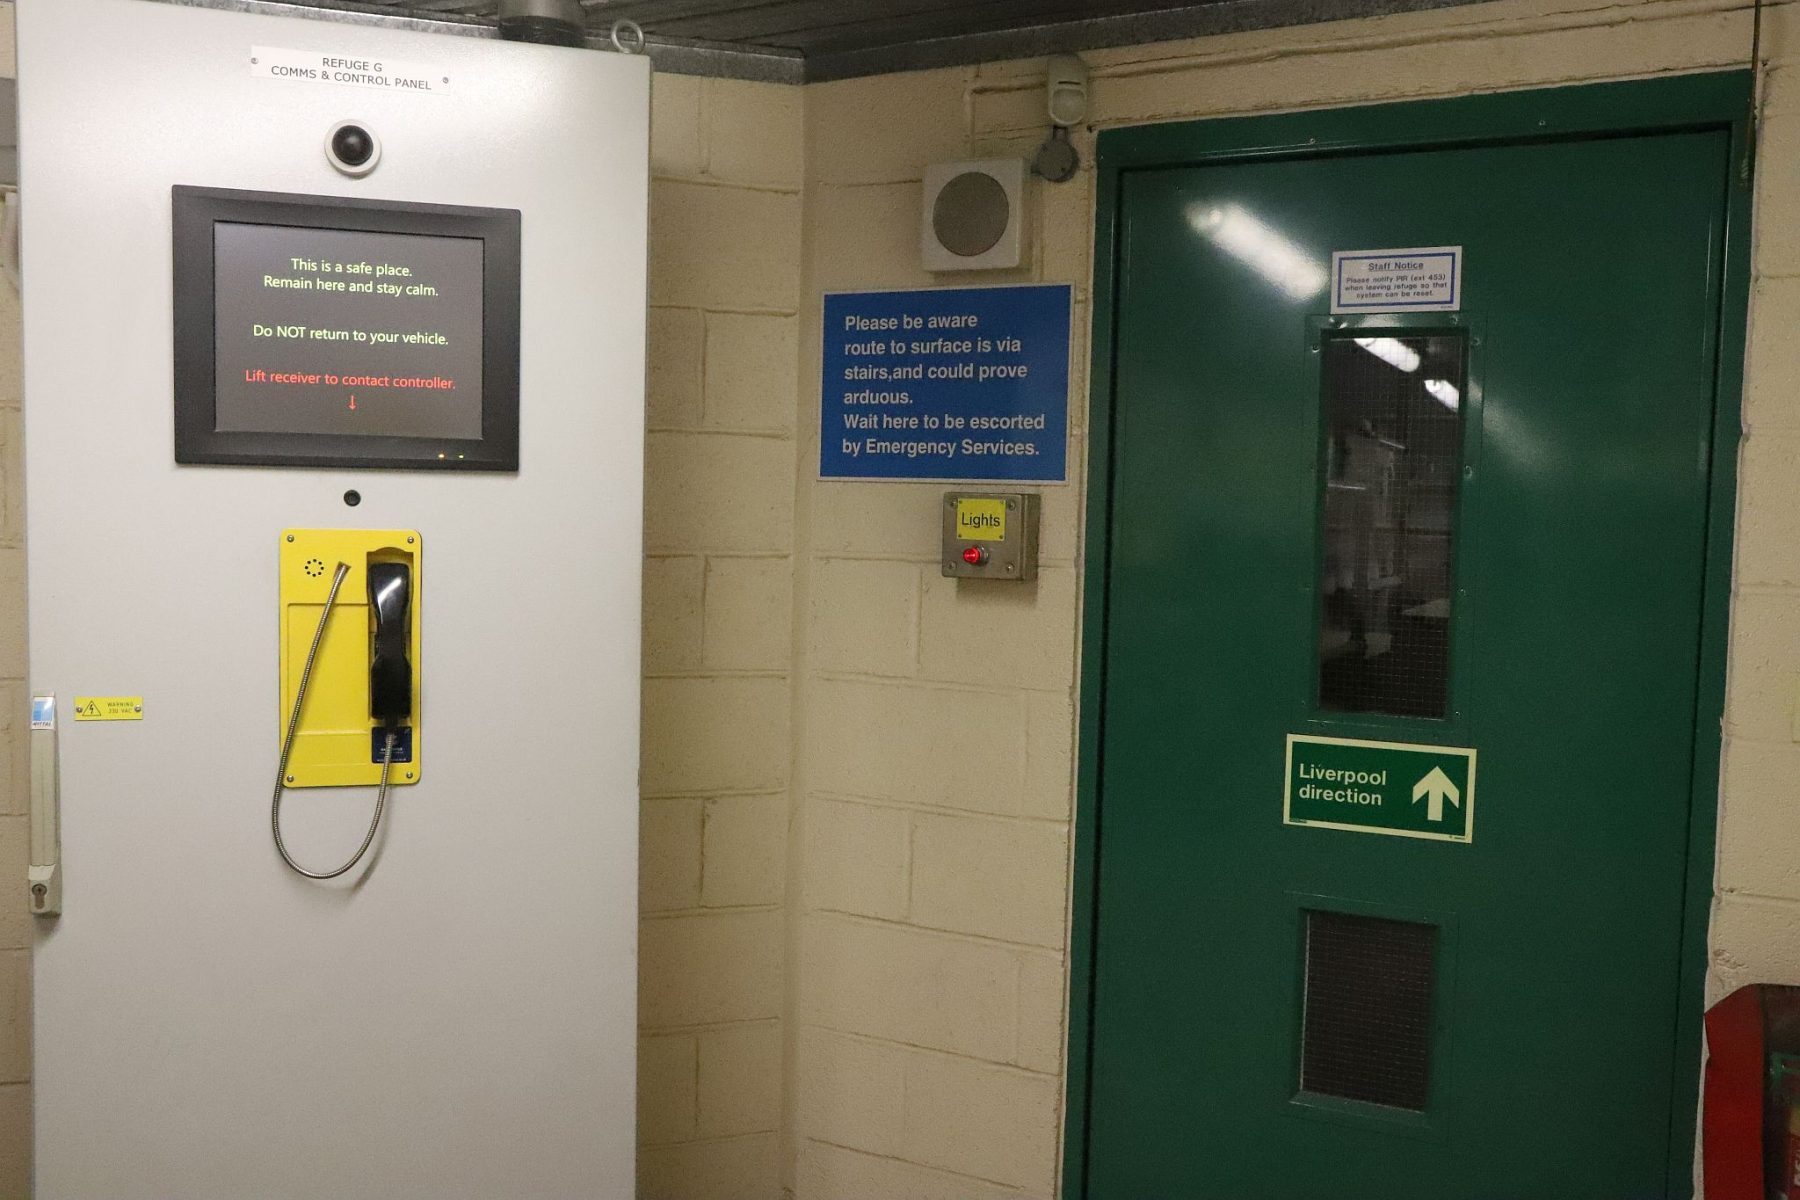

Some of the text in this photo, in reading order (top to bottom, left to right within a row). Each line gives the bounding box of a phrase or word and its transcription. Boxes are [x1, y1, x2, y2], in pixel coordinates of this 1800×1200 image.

[322, 57, 383, 72] REFUGE G
[270, 65, 432, 91] COMMS & CONTROL PANEL
[291, 258, 413, 278] This is a safe place.
[1368, 262, 1391, 271] Staff
[264, 275, 439, 297] Remain here and stay calm.
[1366, 283, 1391, 291] leaving
[1393, 282, 1417, 290] refuge
[1410, 274, 1425, 282] (ext
[844, 314, 978, 331] Please be aware
[253, 324, 449, 345] Do NOT return to your vehicle.
[844, 336, 1022, 356] route to surface is via
[245, 369, 456, 390] Lift receiver to contact controller.
[844, 363, 1028, 382] stairs,and could prove
[843, 389, 914, 404] arduous.
[843, 413, 1045, 430] Wait here to be escorted
[842, 438, 1040, 458] by Emergency Services.
[961, 511, 1000, 528] Lights
[1299, 763, 1387, 786] Liverpool
[1299, 784, 1382, 806] direction
